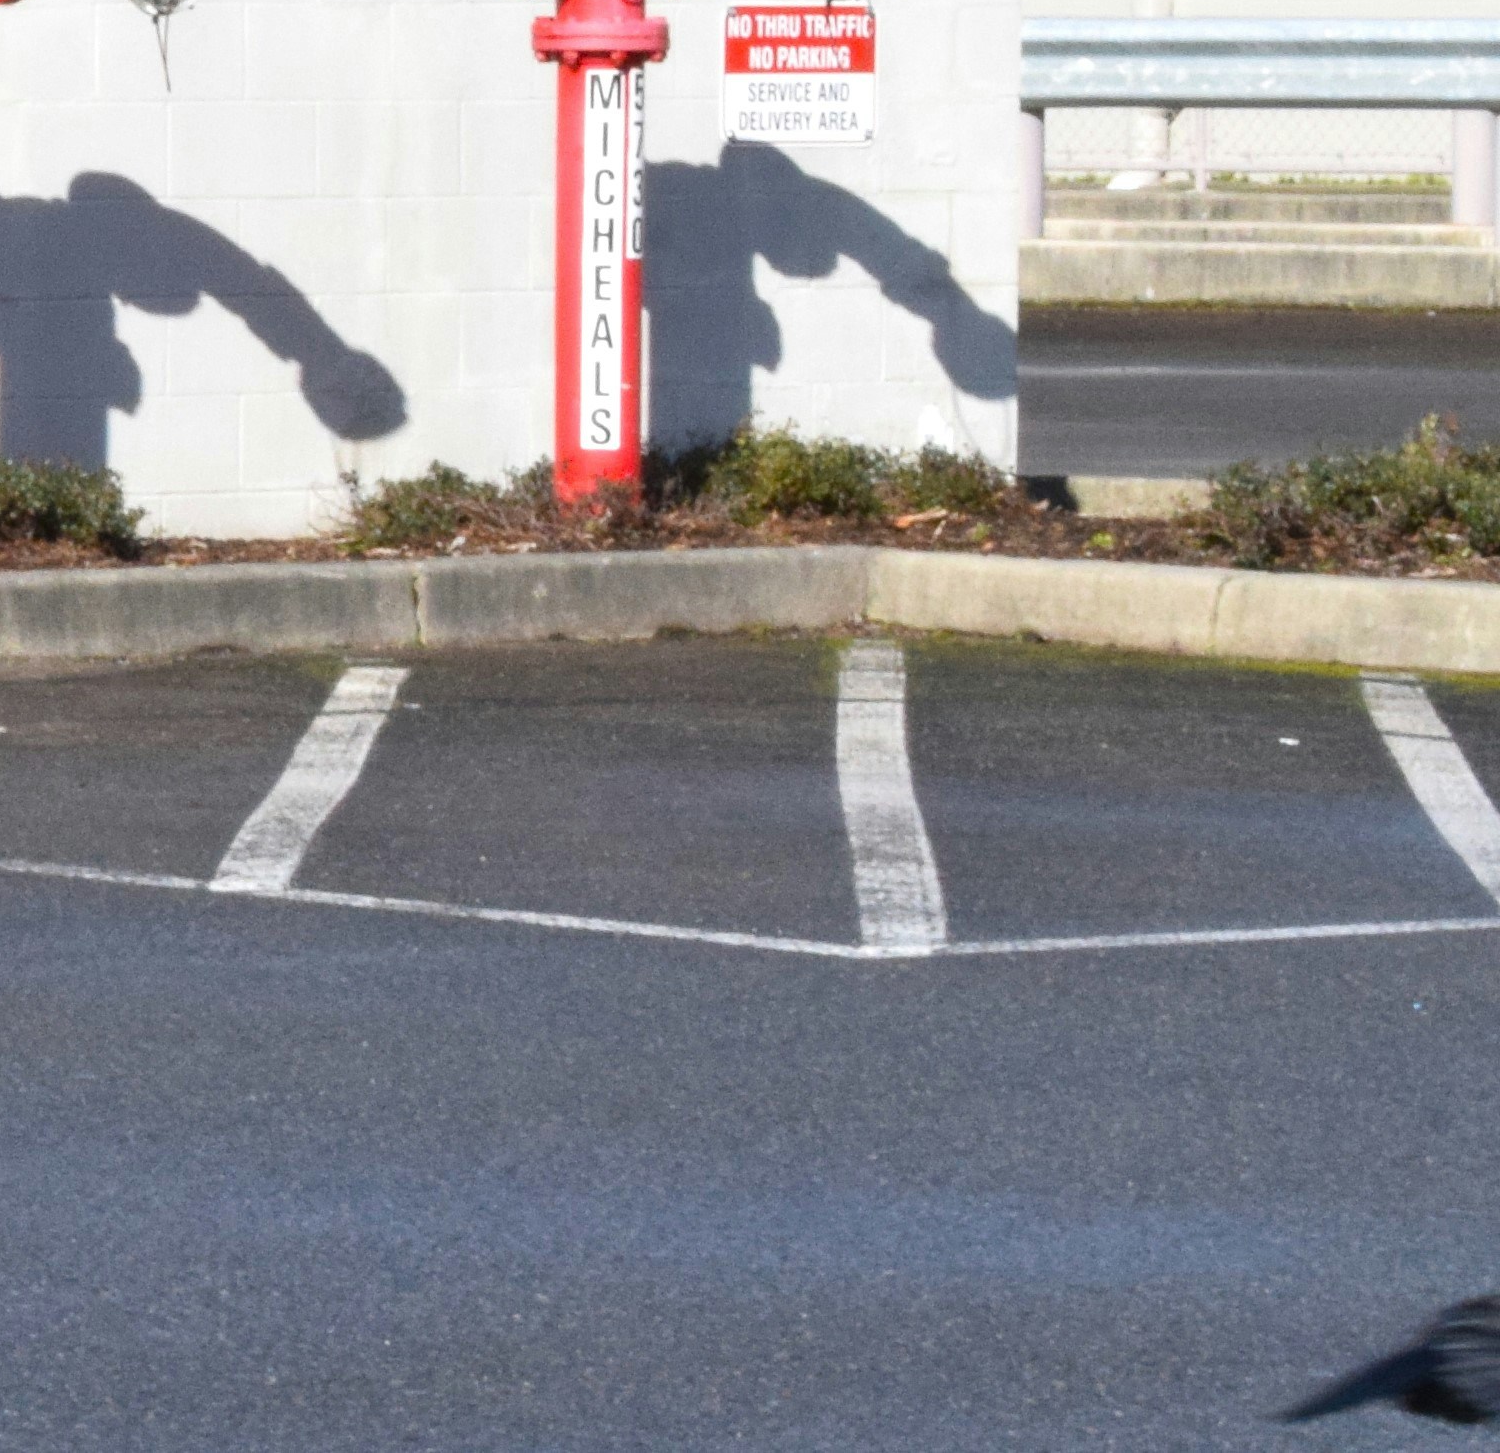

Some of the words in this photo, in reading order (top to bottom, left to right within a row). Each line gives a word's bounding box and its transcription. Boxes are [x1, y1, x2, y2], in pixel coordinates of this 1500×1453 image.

[727, 14, 752, 37] NO
[754, 14, 801, 37] THRU
[803, 14, 874, 37] TRAFFIC
[749, 46, 773, 69] NO
[776, 46, 850, 69] PARKING
[748, 82, 811, 102] SERVICE
[818, 82, 850, 102] AND
[738, 111, 812, 131] DELIVERY
[818, 111, 859, 131] AREA
[589, 74, 622, 445] MICHEALS
